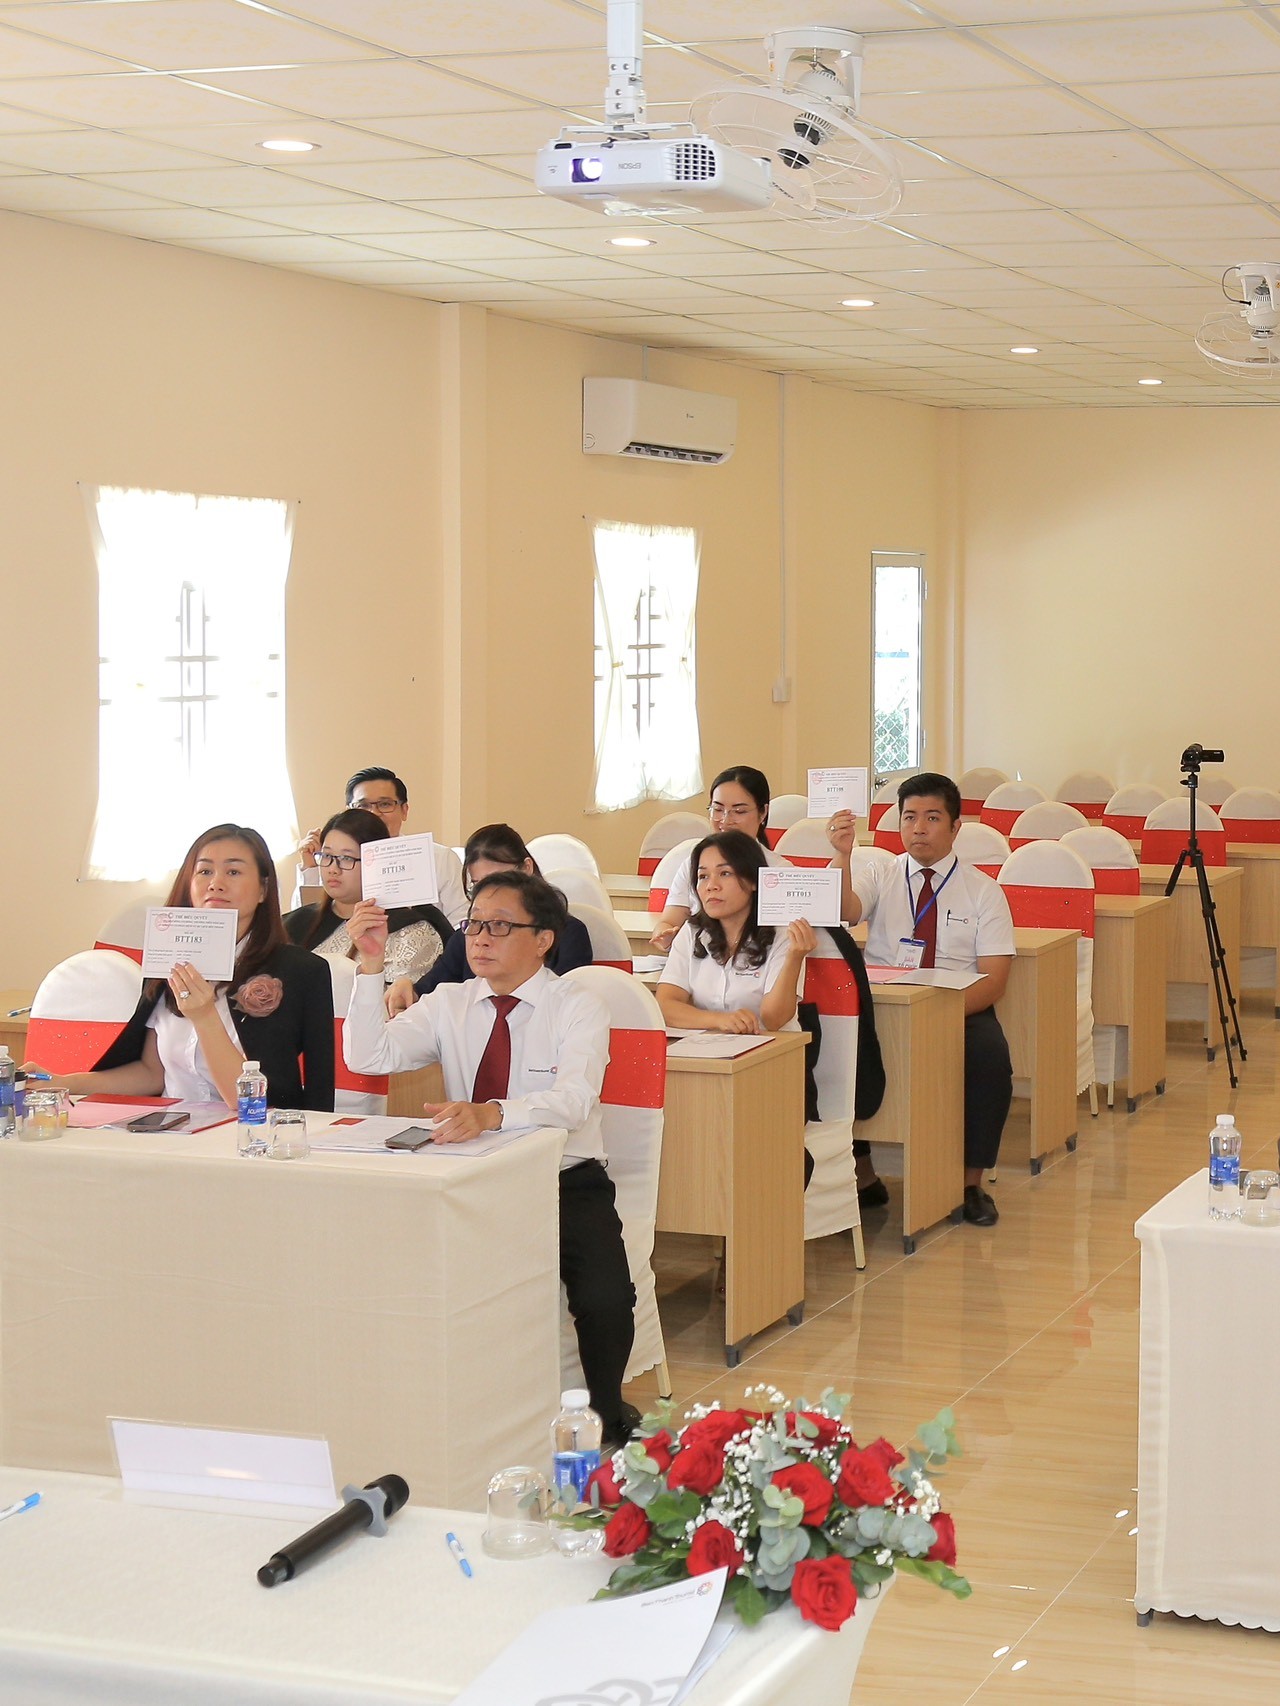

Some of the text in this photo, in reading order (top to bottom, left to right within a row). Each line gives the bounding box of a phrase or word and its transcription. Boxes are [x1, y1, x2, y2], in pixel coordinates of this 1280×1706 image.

[618, 162, 642, 170] EPSON
[382, 865, 406, 875] BTT138
[175, 935, 203, 944] BTT183
